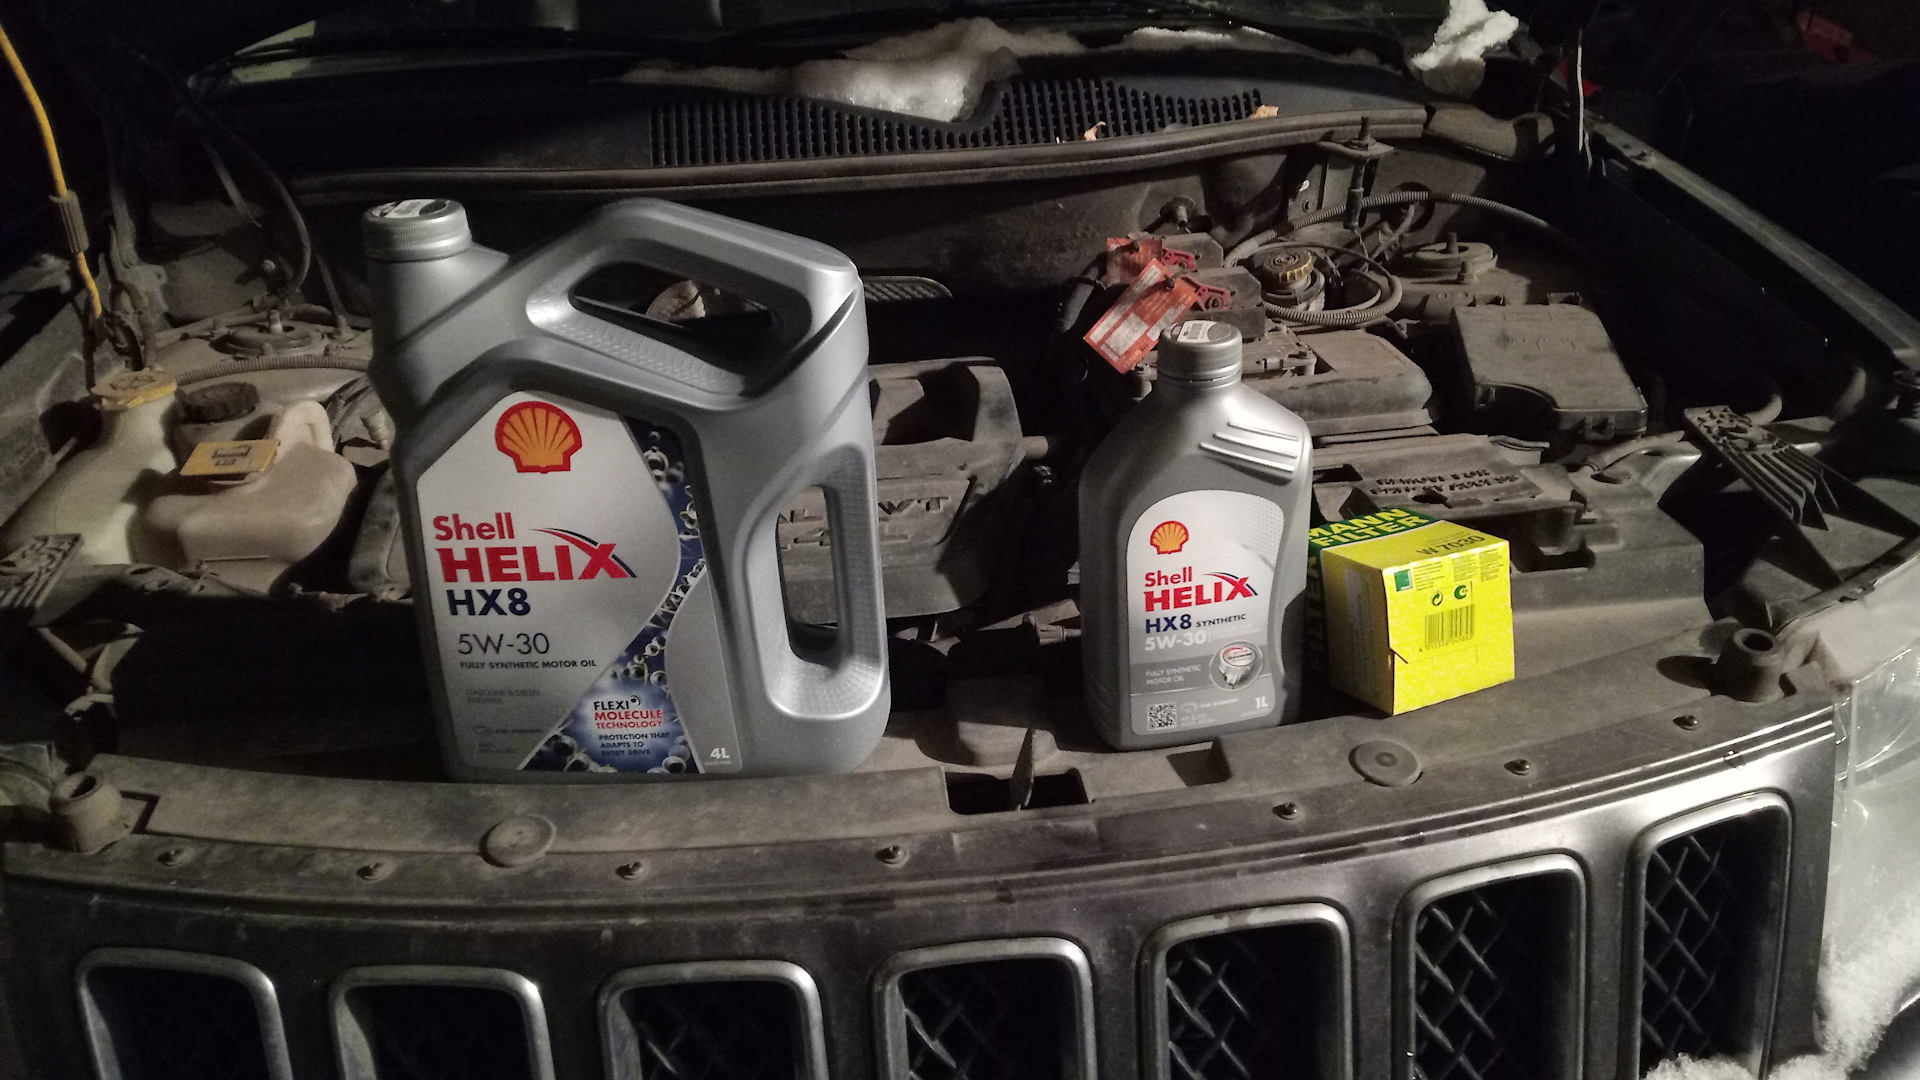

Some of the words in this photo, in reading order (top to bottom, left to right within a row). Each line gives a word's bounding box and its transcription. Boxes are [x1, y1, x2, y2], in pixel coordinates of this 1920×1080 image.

[433, 512, 515, 541] Shell
[1309, 508, 1411, 539] MANN
[1310, 515, 1430, 547] FILTER
[1416, 547, 1439, 555] W
[1436, 535, 1486, 551] 7030
[436, 543, 636, 582] HELIX
[1144, 566, 1193, 587] Shell
[446, 588, 531, 616] HX8
[1144, 575, 1258, 612] HELIX
[1145, 614, 1192, 634] HX8
[1196, 614, 1247, 628] SYNTHETIC
[457, 633, 549, 656] 5W-30
[1144, 630, 1207, 652] 5W-30
[460, 661, 486, 669] FULLY
[488, 661, 539, 669] SYNTHETIC
[542, 660, 578, 668] MOTOR
[580, 659, 597, 668] OIL
[594, 700, 630, 711] FLEXI
[1254, 696, 1269, 709] 1L
[594, 709, 663, 721] MOLECULE
[596, 720, 663, 729] TECHNOLOGY
[599, 733, 648, 741] PROTECTION
[628, 748, 651, 756] DRIVE
[709, 747, 731, 760] 4L
